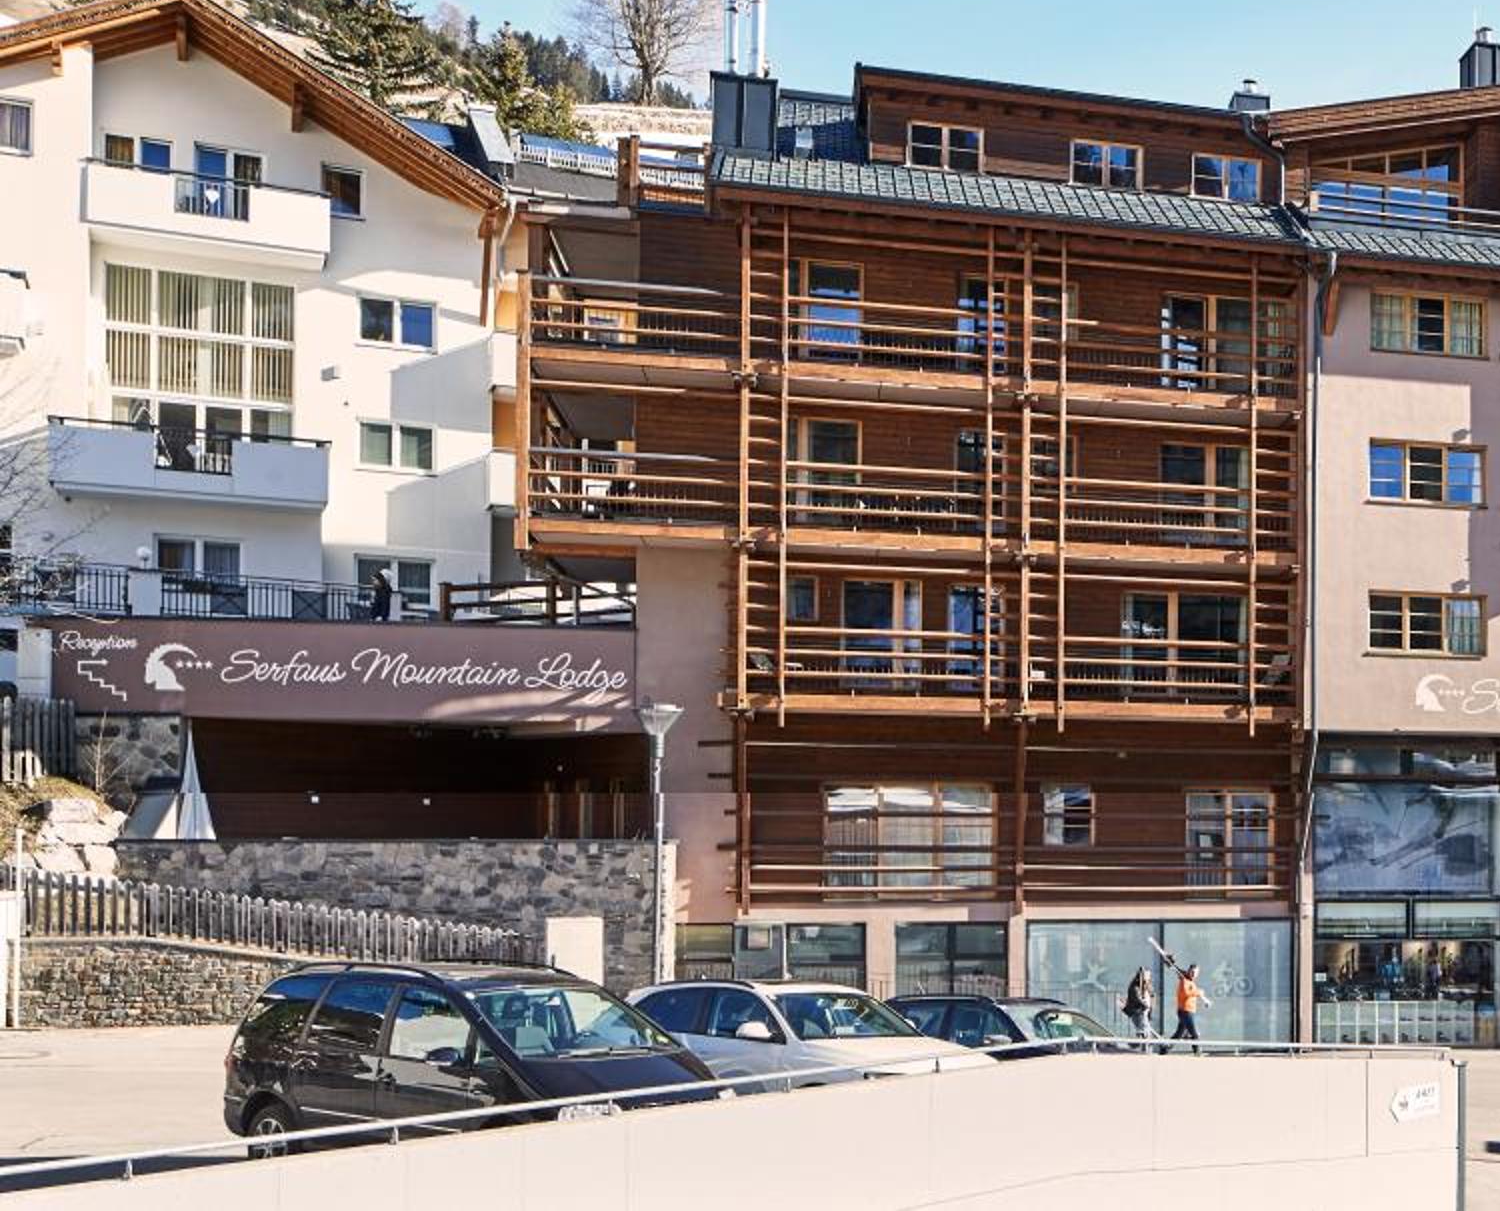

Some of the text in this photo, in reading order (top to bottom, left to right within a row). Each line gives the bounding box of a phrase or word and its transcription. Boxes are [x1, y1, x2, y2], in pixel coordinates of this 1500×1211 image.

[59, 630, 137, 657] Reception
[221, 648, 628, 700] Serfaus Mountain Lodge
